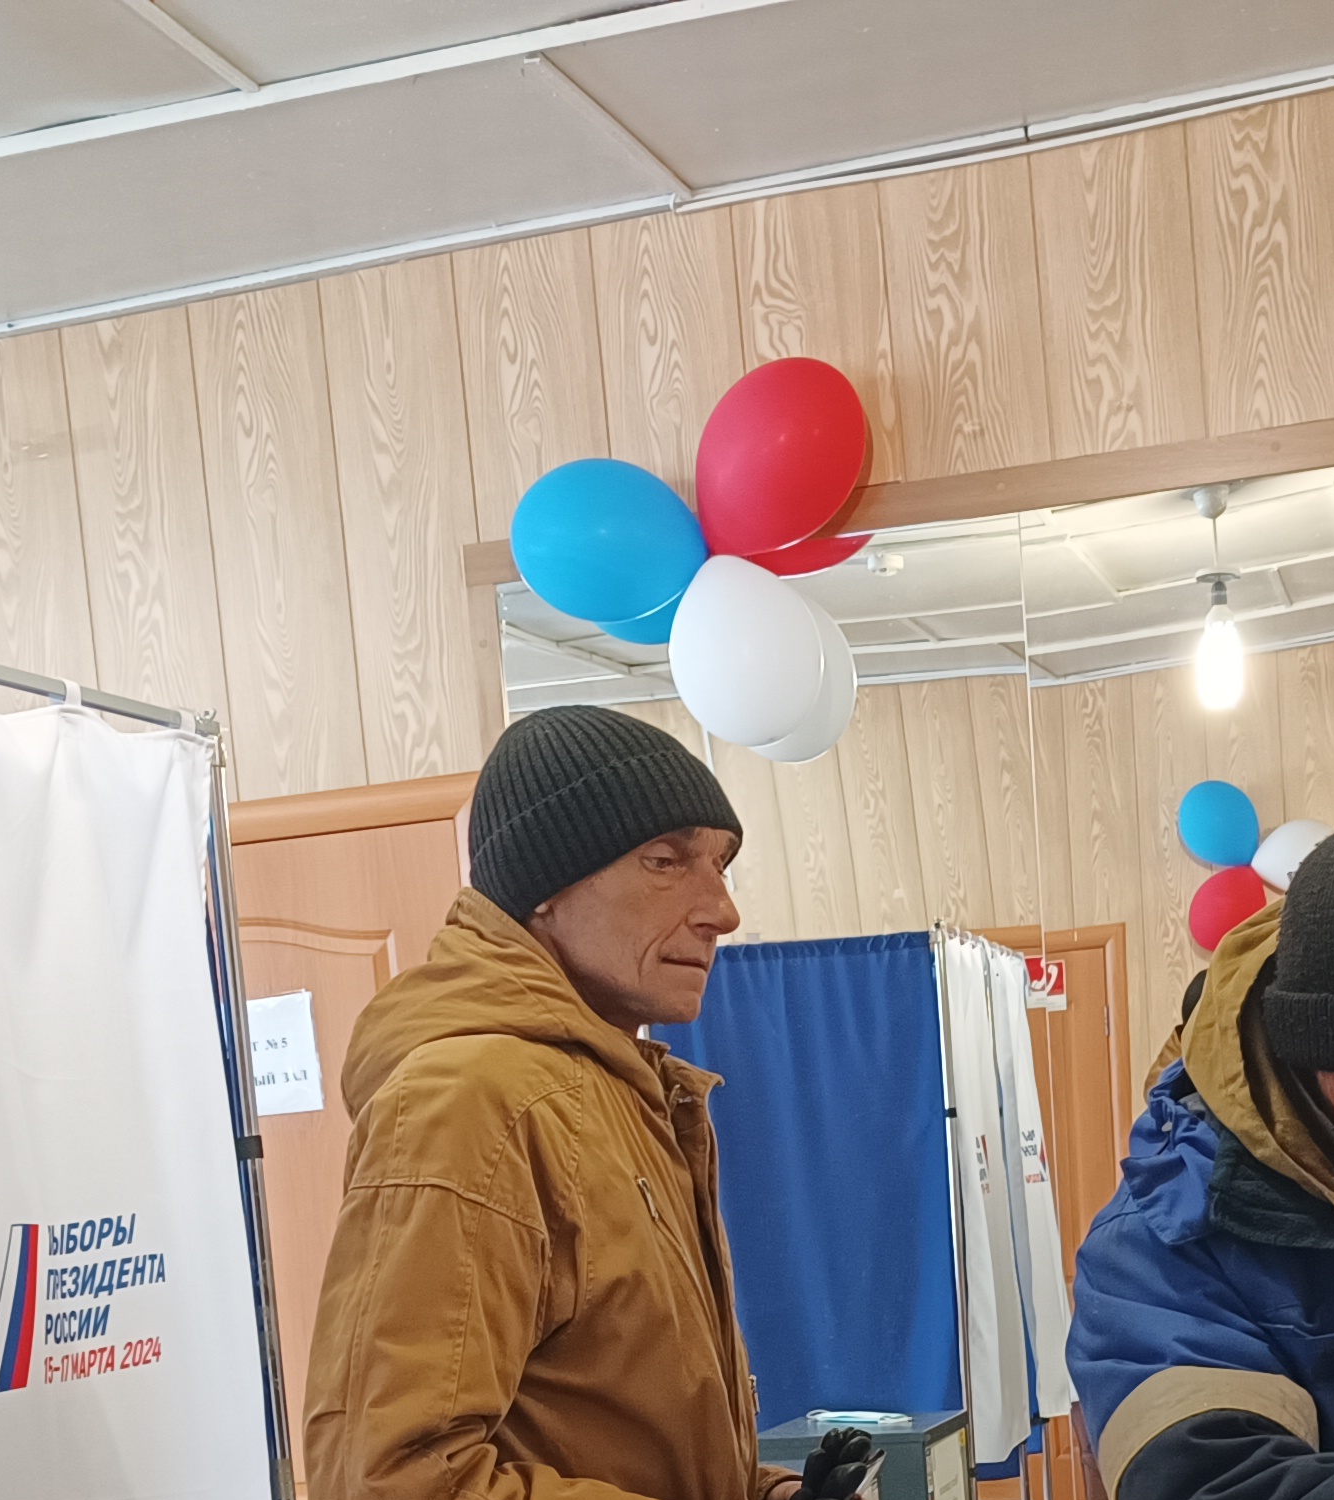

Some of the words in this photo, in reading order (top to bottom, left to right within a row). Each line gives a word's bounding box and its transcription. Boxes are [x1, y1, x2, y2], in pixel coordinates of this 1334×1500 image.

[47, 1213, 136, 1256] ЫБОРЫ
[45, 1304, 110, 1345] РОССИИ
[120, 1336, 161, 1369] 2024
